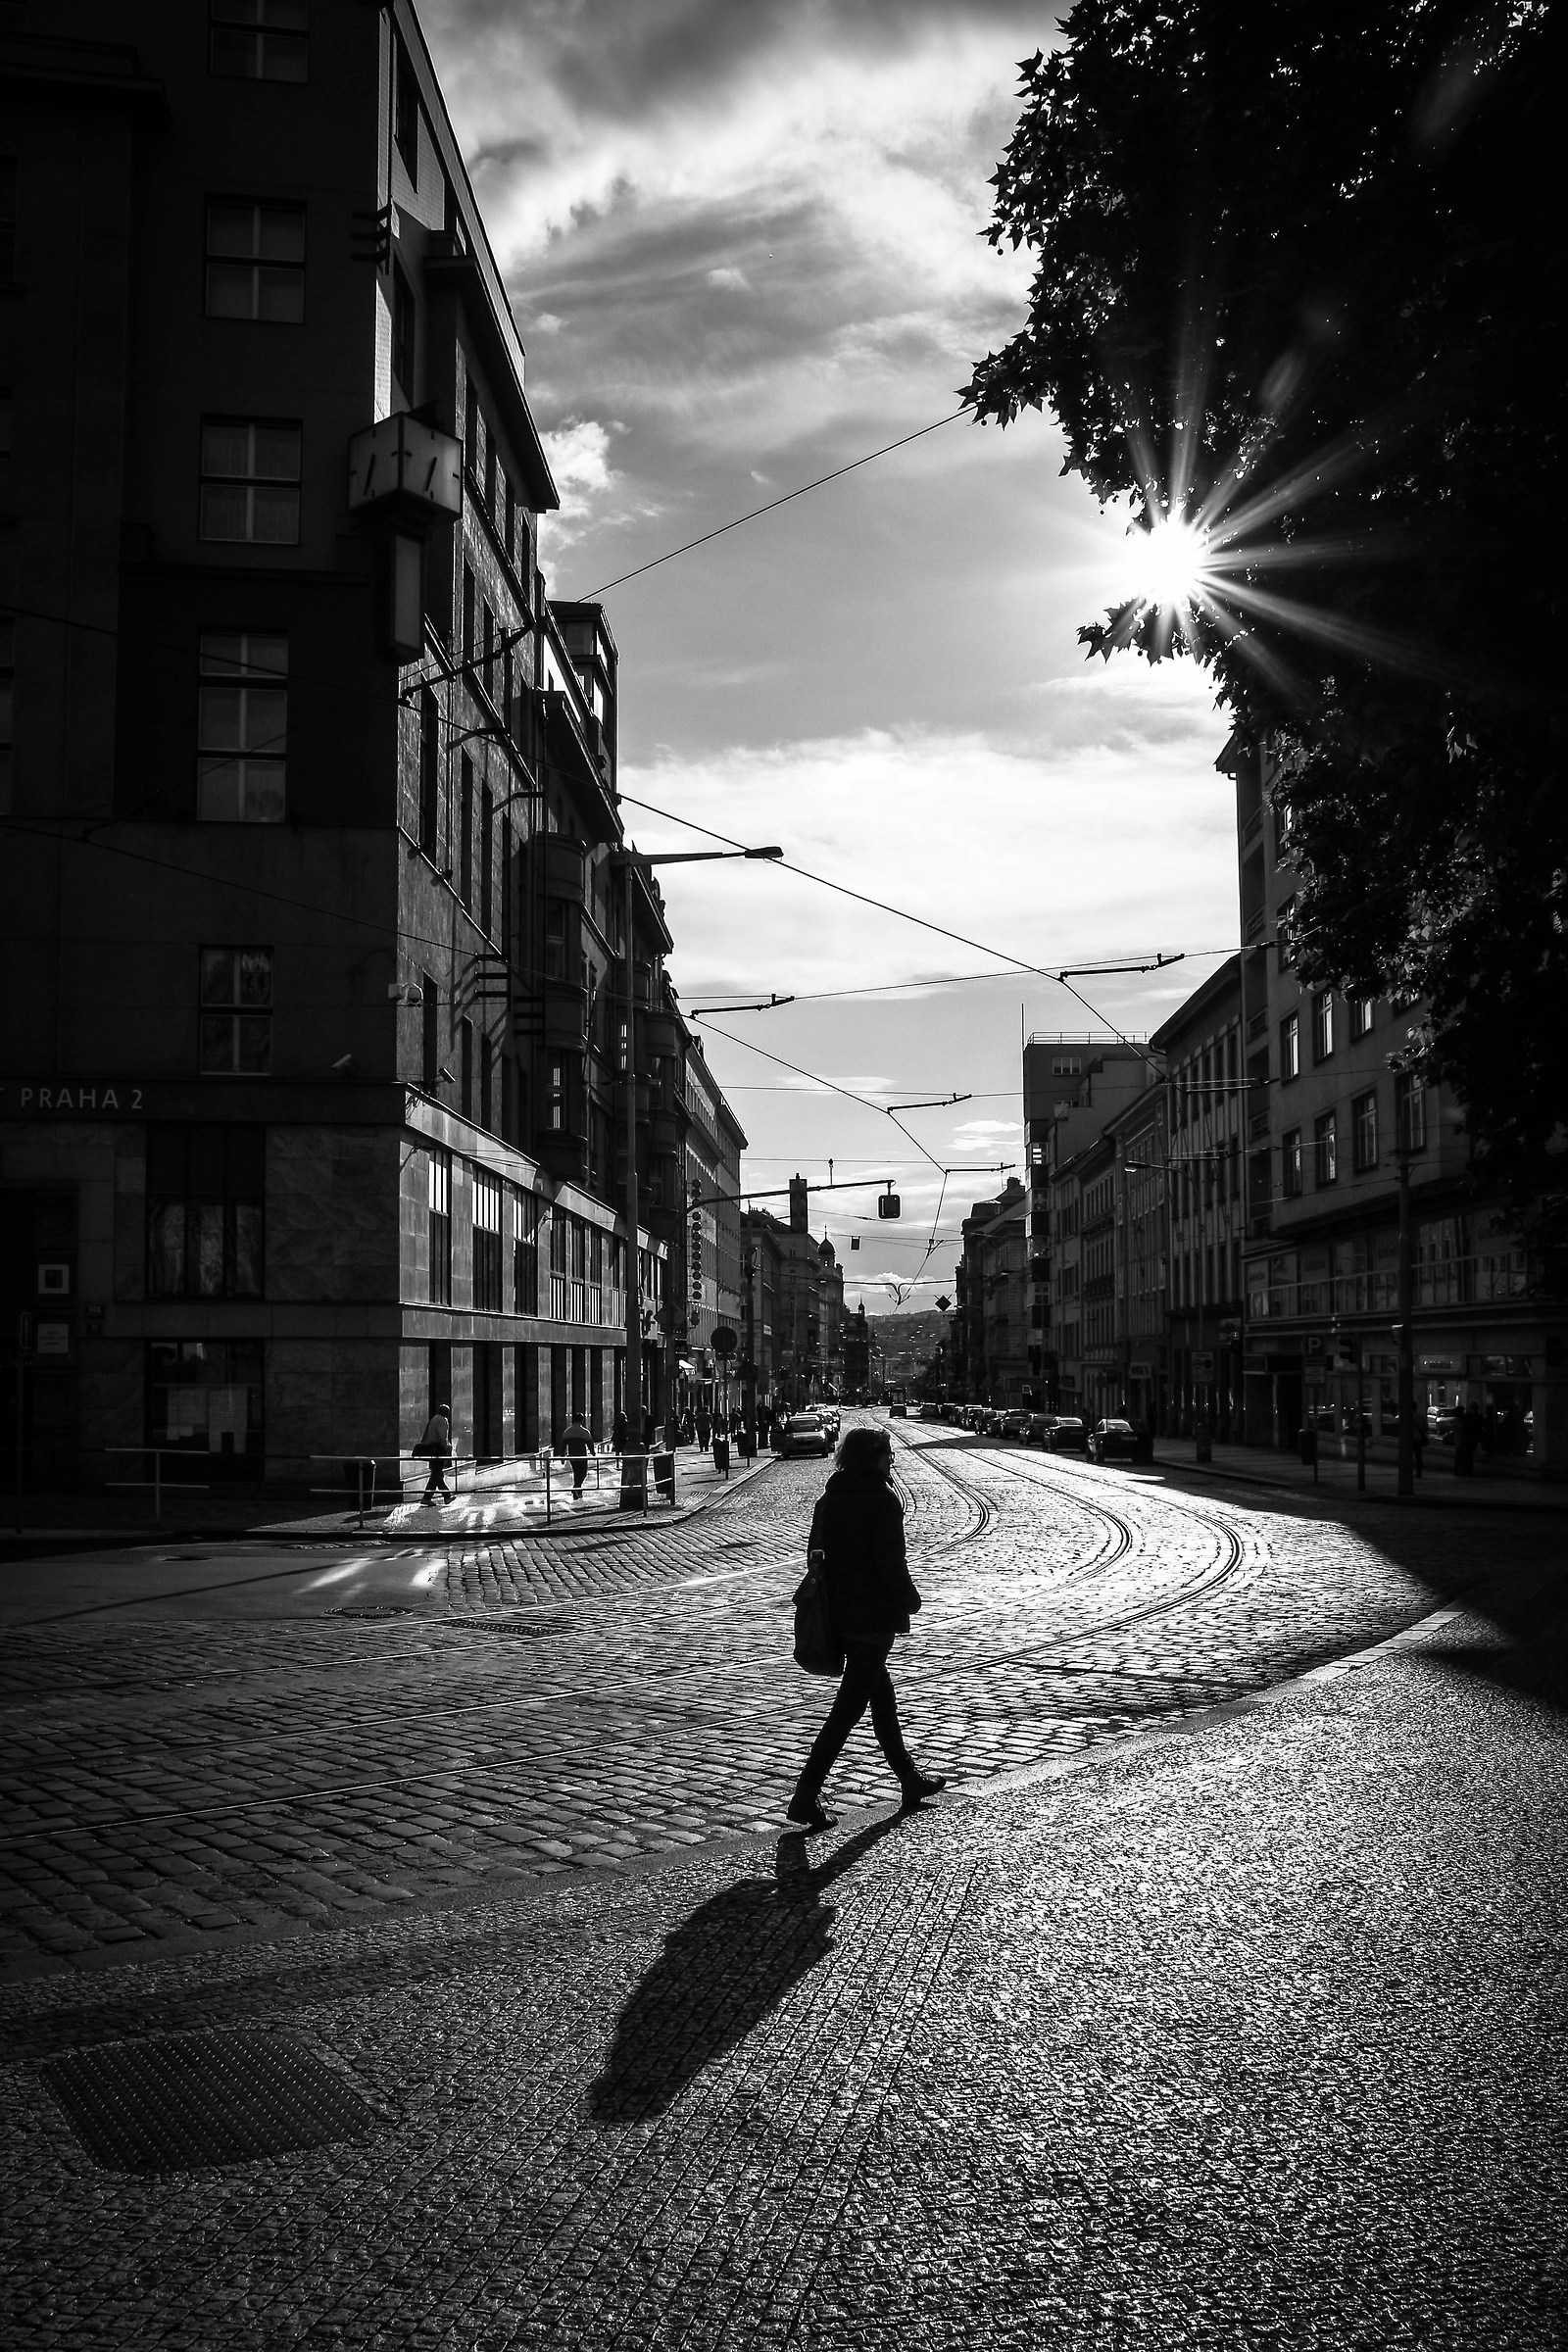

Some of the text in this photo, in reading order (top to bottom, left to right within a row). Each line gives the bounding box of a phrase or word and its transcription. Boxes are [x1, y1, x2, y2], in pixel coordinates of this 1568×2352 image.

[21, 1087, 144, 1109] PRAHA 2
[1308, 1337, 1321, 1355] P
